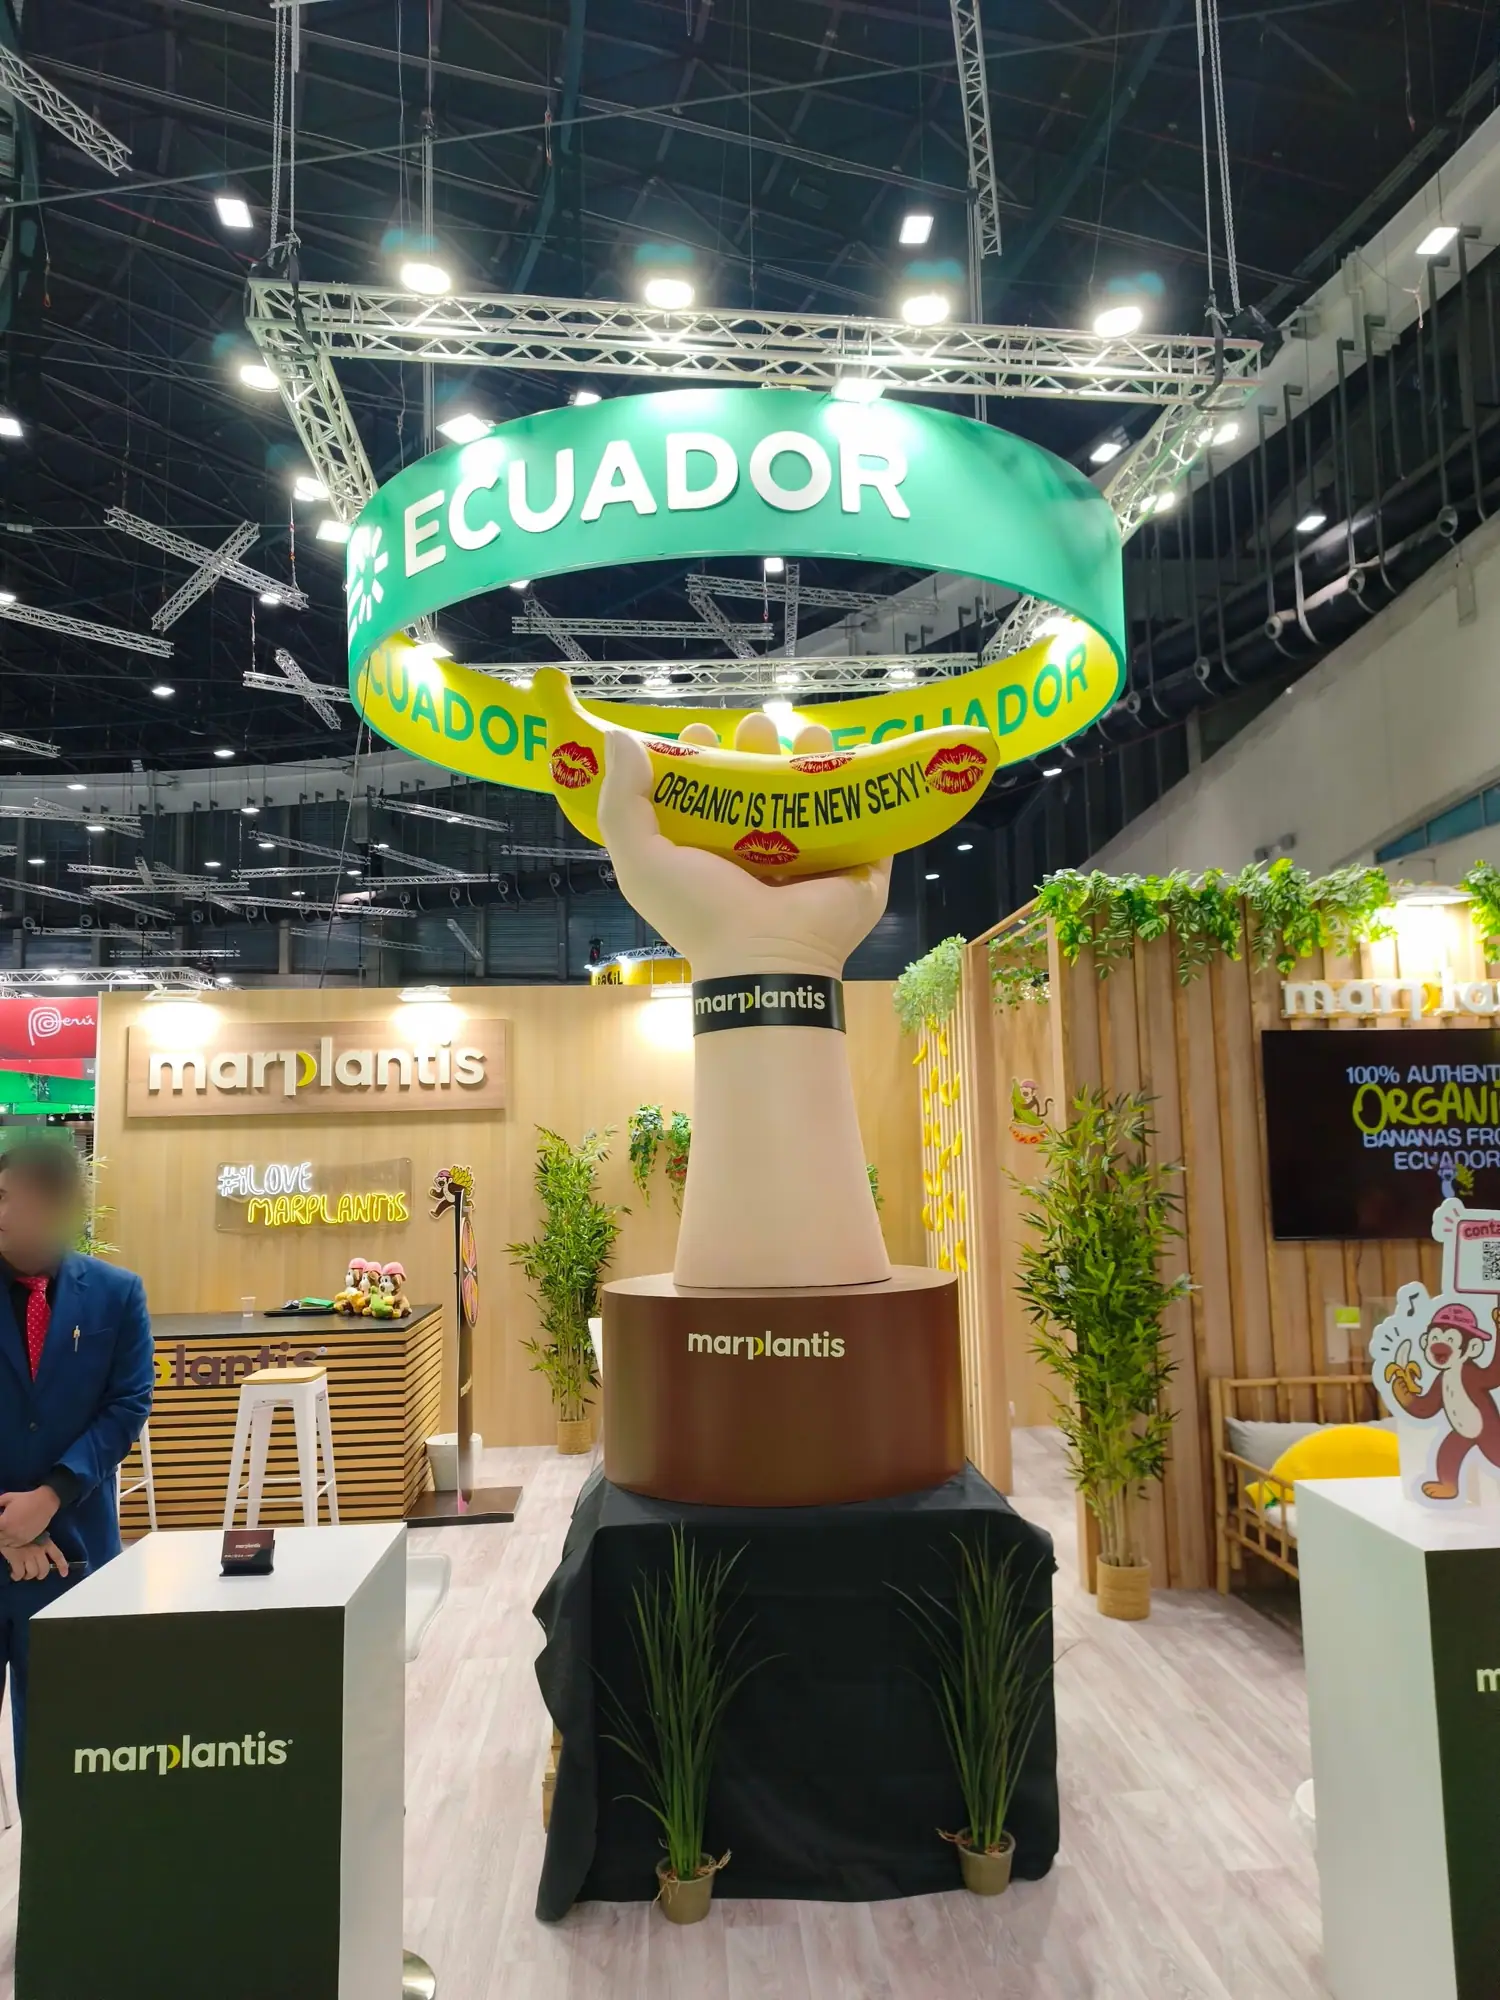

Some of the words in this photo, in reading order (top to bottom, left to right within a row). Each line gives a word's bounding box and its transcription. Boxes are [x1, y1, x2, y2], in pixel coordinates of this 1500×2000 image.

[404, 430, 911, 578] ECUADOR
[653, 771, 744, 826] ORGANIC
[744, 791, 765, 828] IS
[770, 791, 810, 829] THE
[814, 783, 862, 826] NEW
[864, 760, 931, 815] SEXY!
[694, 985, 826, 1016] marplantis
[1284, 966, 1500, 1021] marpla
[28, 1006, 96, 1046] Perú
[148, 1036, 487, 1096] marplantis
[1346, 1065, 1400, 1084] 100%
[1363, 1128, 1461, 1148] BANANAS
[1394, 1150, 1500, 1170] ECUADOR
[687, 1330, 846, 1360] marplantis
[74, 1730, 288, 1776] marplantis
